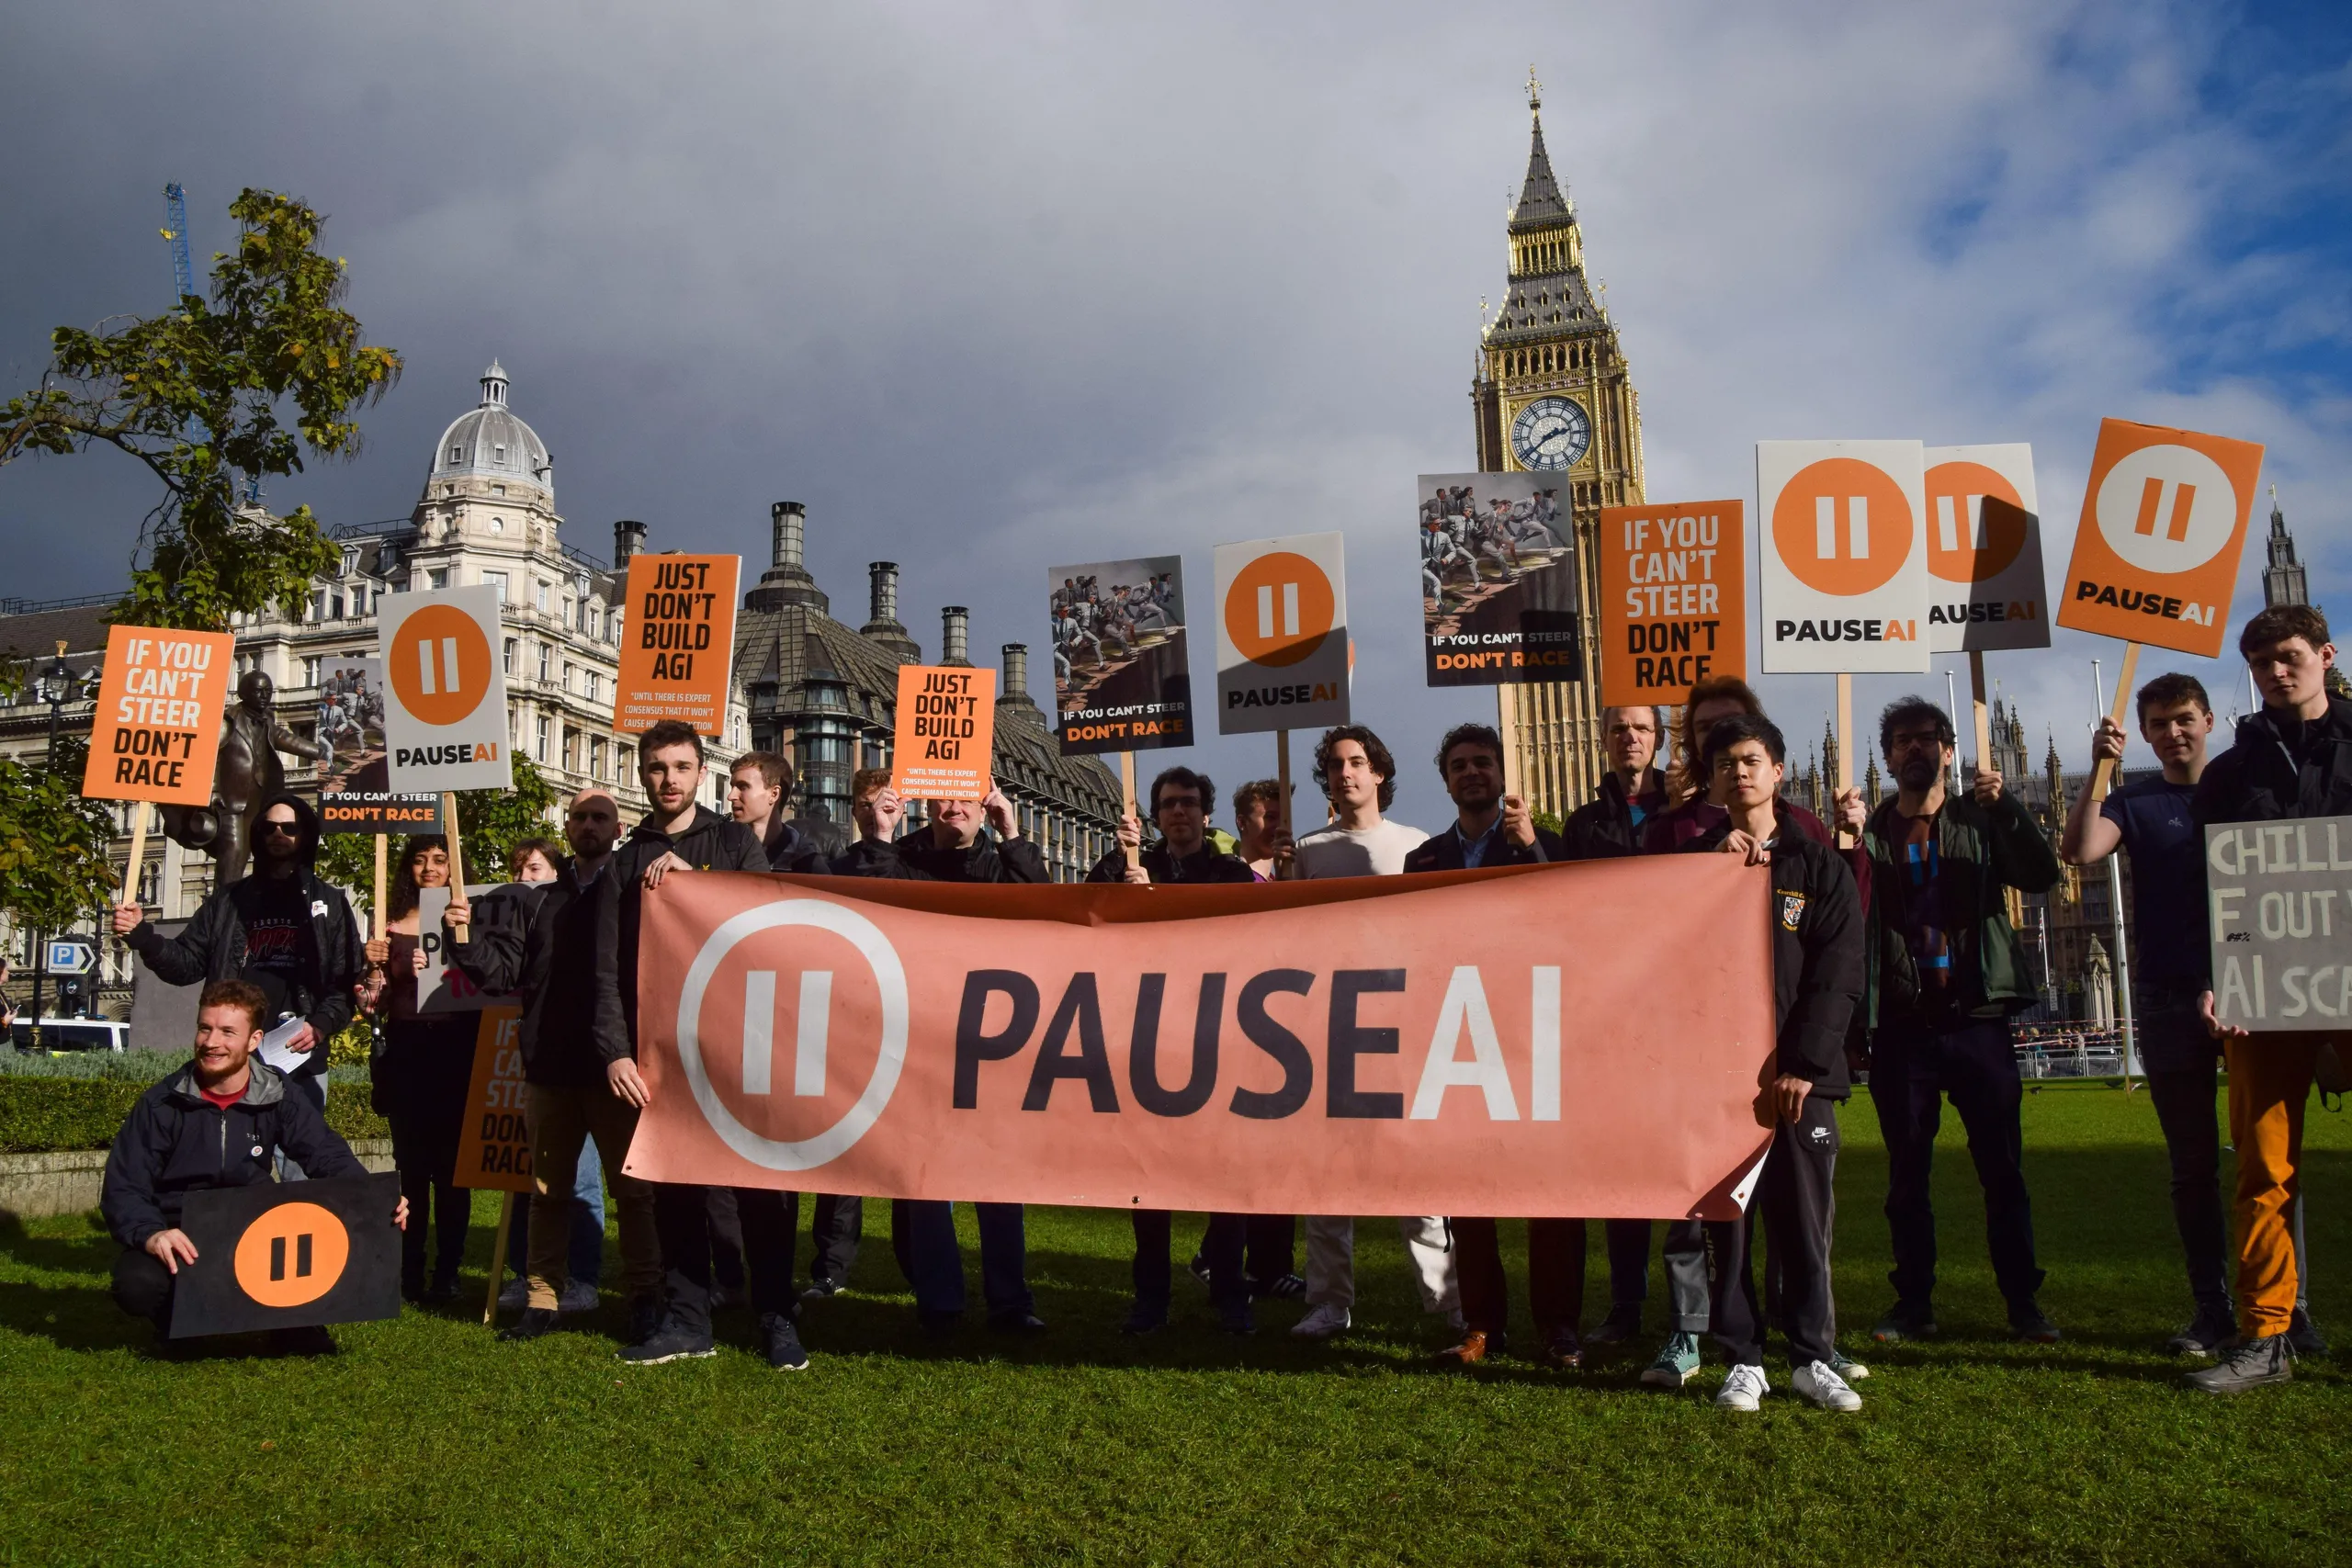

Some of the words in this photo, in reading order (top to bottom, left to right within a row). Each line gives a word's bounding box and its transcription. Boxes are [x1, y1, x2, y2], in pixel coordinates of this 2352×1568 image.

[1624, 519, 1649, 550] IF
[1657, 515, 1718, 547] YOU
[654, 563, 709, 590] JUST
[1629, 549, 1716, 584] CAN'T
[644, 593, 716, 620] DON'T
[1626, 583, 1718, 617] STEER
[1929, 601, 2035, 624] AUSEAI
[2076, 581, 2215, 626] PAUSEAI
[642, 623, 710, 650] BUILD
[1432, 636, 1445, 646] IF
[1449, 635, 1478, 645] YOU
[1482, 633, 1523, 644] CAN'T
[1529, 632, 1571, 642] STEER
[1628, 620, 1720, 654] DON'T
[1775, 619, 1917, 642] PAUSEAI
[126, 639, 152, 665] IF
[159, 641, 211, 670] YOU
[651, 653, 693, 680] AGI
[1436, 651, 1505, 670] DON'T
[1511, 650, 1569, 667] RACE
[126, 668, 205, 698] CAN'T
[923, 673, 971, 694] JUST
[1635, 655, 1711, 688] RACE
[655, 693, 675, 702] THERE
[677, 694, 684, 702] IS
[684, 694, 711, 703] EXPERT
[916, 695, 978, 716] DON'T
[1228, 682, 1337, 709] PAUSEAI
[118, 696, 200, 728] STEER
[624, 718, 644, 728] CAUSE
[625, 705, 663, 715] CONSENSUS
[665, 706, 682, 716] THAT
[683, 707, 690, 716] IT
[691, 707, 714, 716] WON'T
[1064, 711, 1075, 720] IF
[1078, 709, 1102, 718] YOU
[1106, 705, 1144, 716] CAN'T
[1147, 702, 1185, 714] STEER
[915, 716, 974, 739] BUILD
[1067, 723, 1126, 741] DON'T
[1132, 718, 1184, 736] RACE
[114, 728, 197, 759] DON'T
[396, 742, 498, 767] PAUSEAI
[925, 739, 960, 761] AGI
[115, 757, 184, 787] RACE
[928, 768, 946, 776] THERE
[336, 793, 360, 801] YOU
[401, 793, 437, 802] STEER
[324, 807, 381, 820] DON'T
[386, 808, 435, 820] RACE
[2209, 824, 2352, 874] CHILL
[2260, 889, 2337, 940] OUT
[58, 948, 71, 963] P
[2219, 954, 2267, 1019] AI
[495, 1019, 517, 1046] IF
[952, 965, 1562, 1122] PAUSEAI
[485, 1080, 526, 1109] STE
